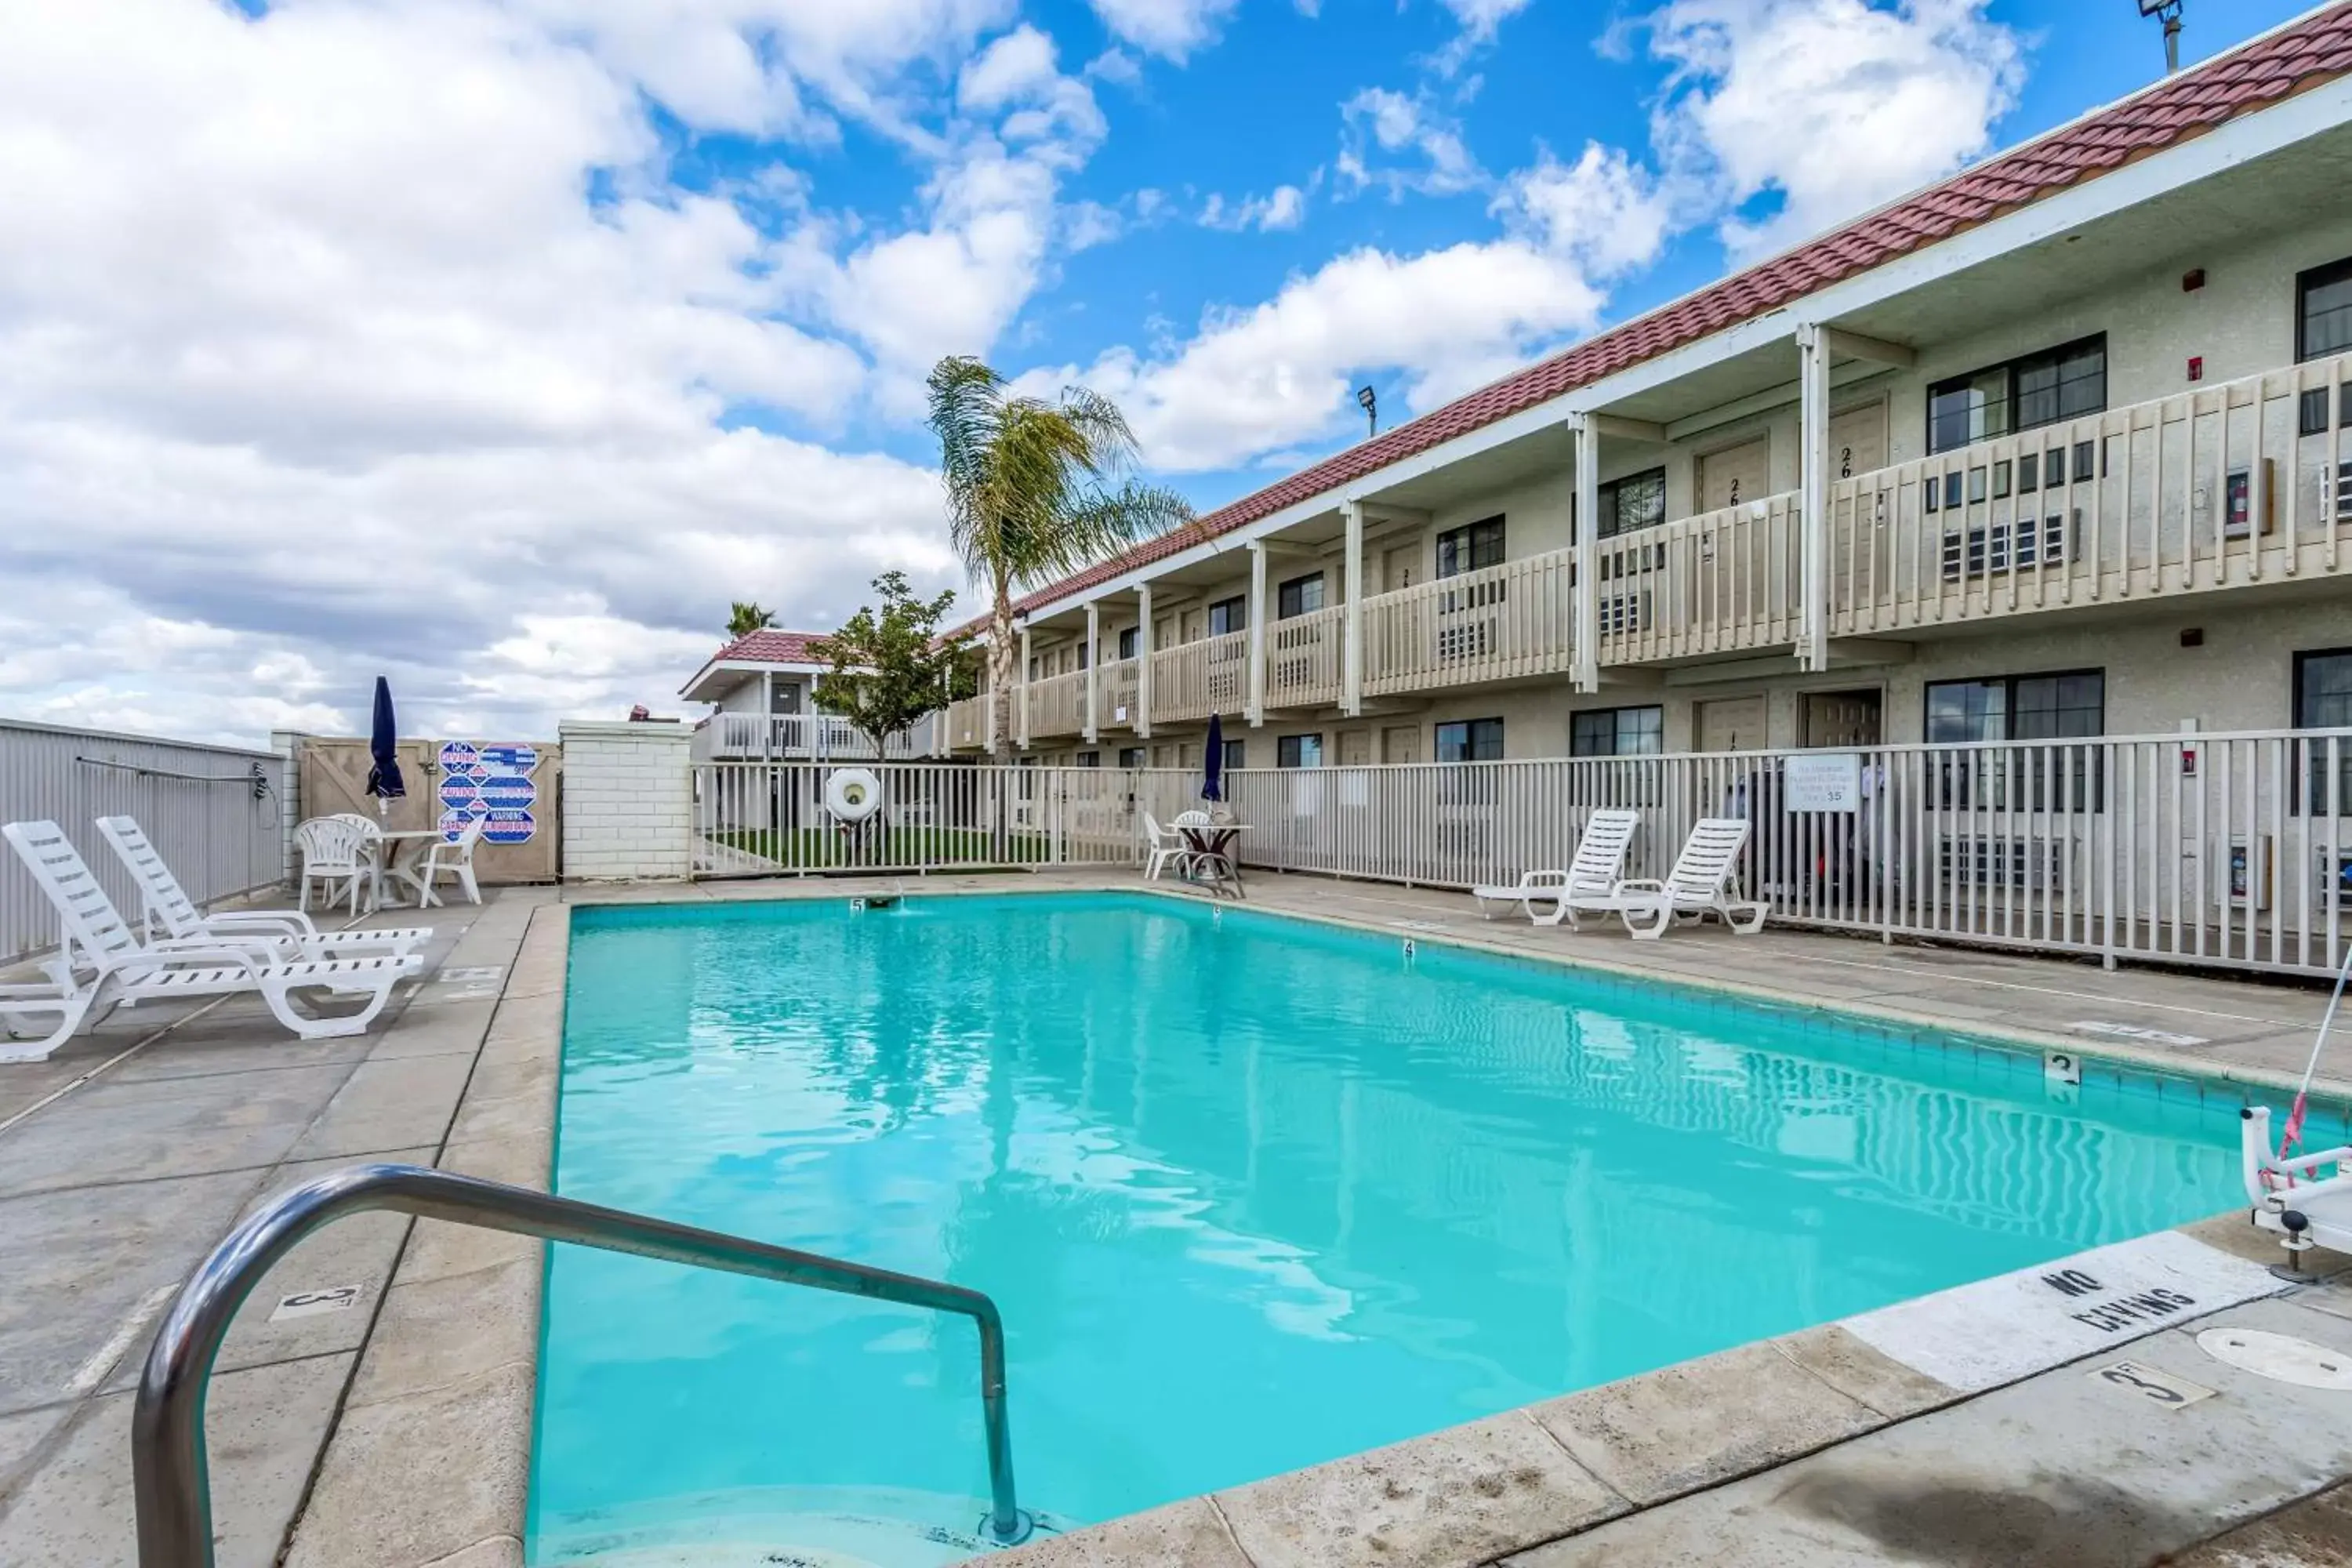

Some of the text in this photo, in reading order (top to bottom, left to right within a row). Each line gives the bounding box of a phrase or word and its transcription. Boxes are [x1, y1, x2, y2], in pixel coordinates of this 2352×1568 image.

[452, 742, 468, 752] NO
[2041, 1269, 2104, 1298] NO
[2070, 1288, 2196, 1333] DIVING
[2100, 1370, 2184, 1403] 3
